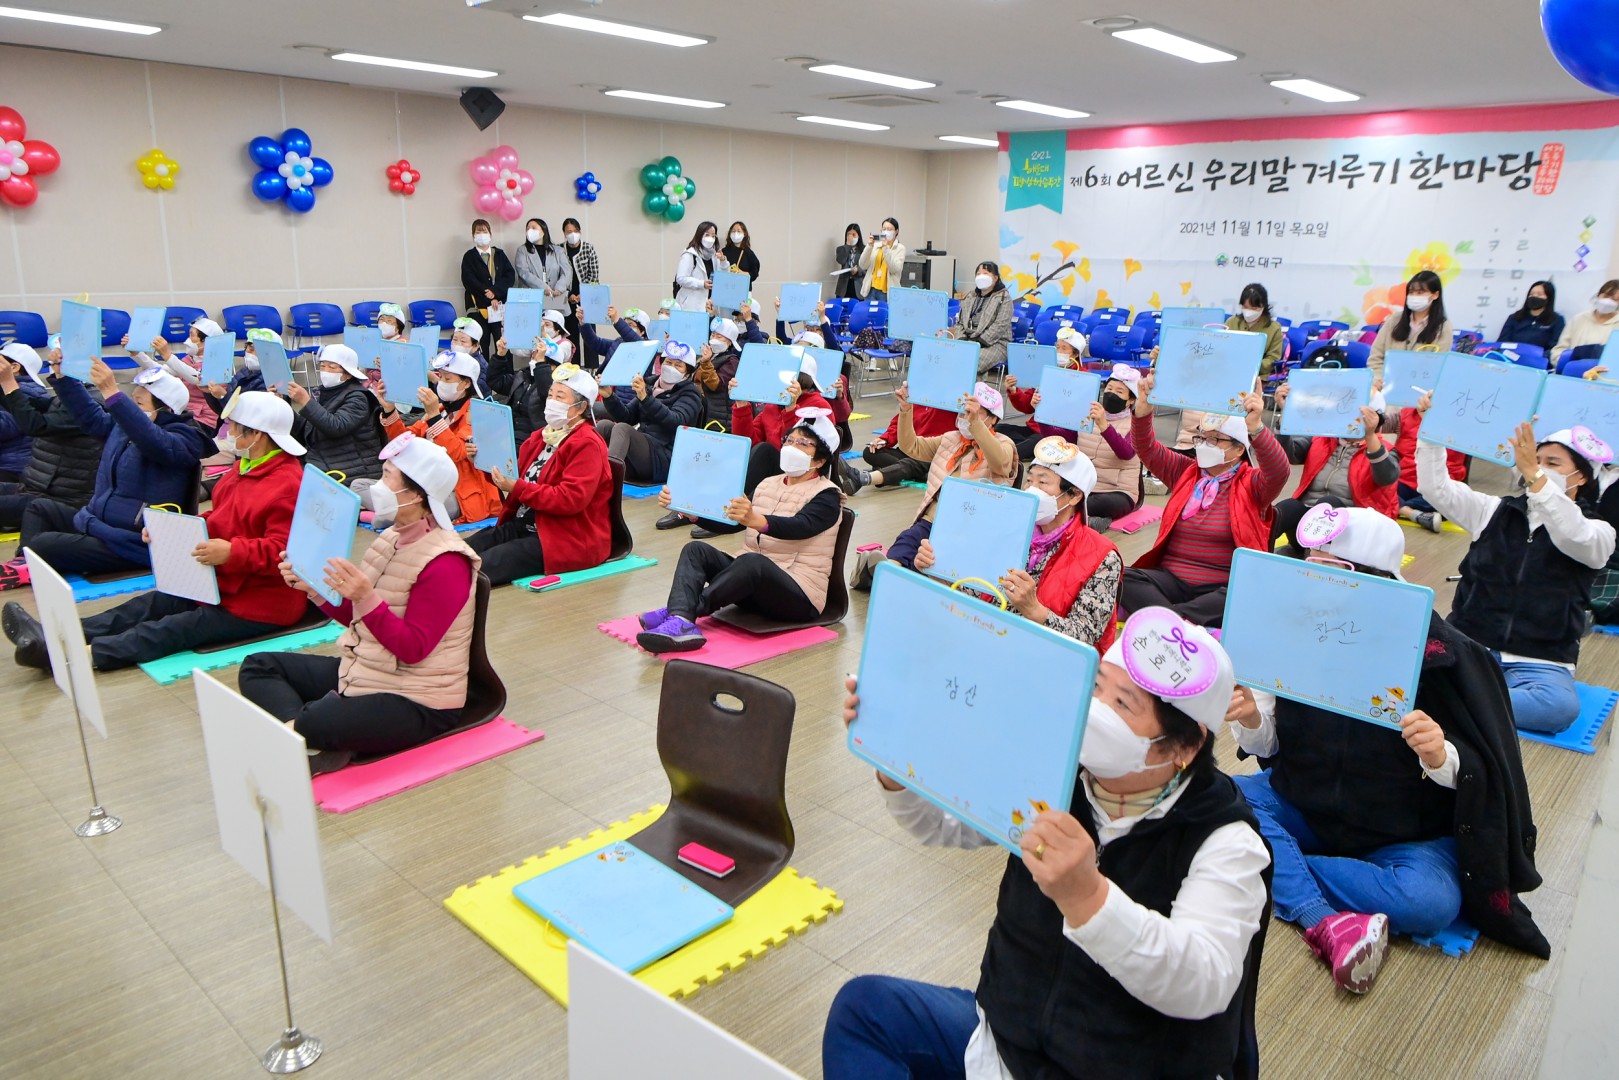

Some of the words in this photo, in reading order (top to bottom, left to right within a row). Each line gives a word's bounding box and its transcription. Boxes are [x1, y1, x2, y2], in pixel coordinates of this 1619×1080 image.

[1070, 166, 1111, 188] 제6회
[1117, 160, 1194, 193] 어르신
[1202, 156, 1296, 193] 우리말
[1301, 154, 1400, 189] 겨루기
[1409, 150, 1542, 190] 한마당
[1180, 221, 1216, 237] 2021년
[1221, 219, 1250, 237] 11월
[1256, 220, 1286, 238] 11일
[1289, 222, 1329, 238] 목요일
[1232, 256, 1283, 269] 해운대구
[1451, 387, 1500, 424] 장산
[1314, 620, 1362, 645] 장산
[945, 676, 977, 707] 장산
